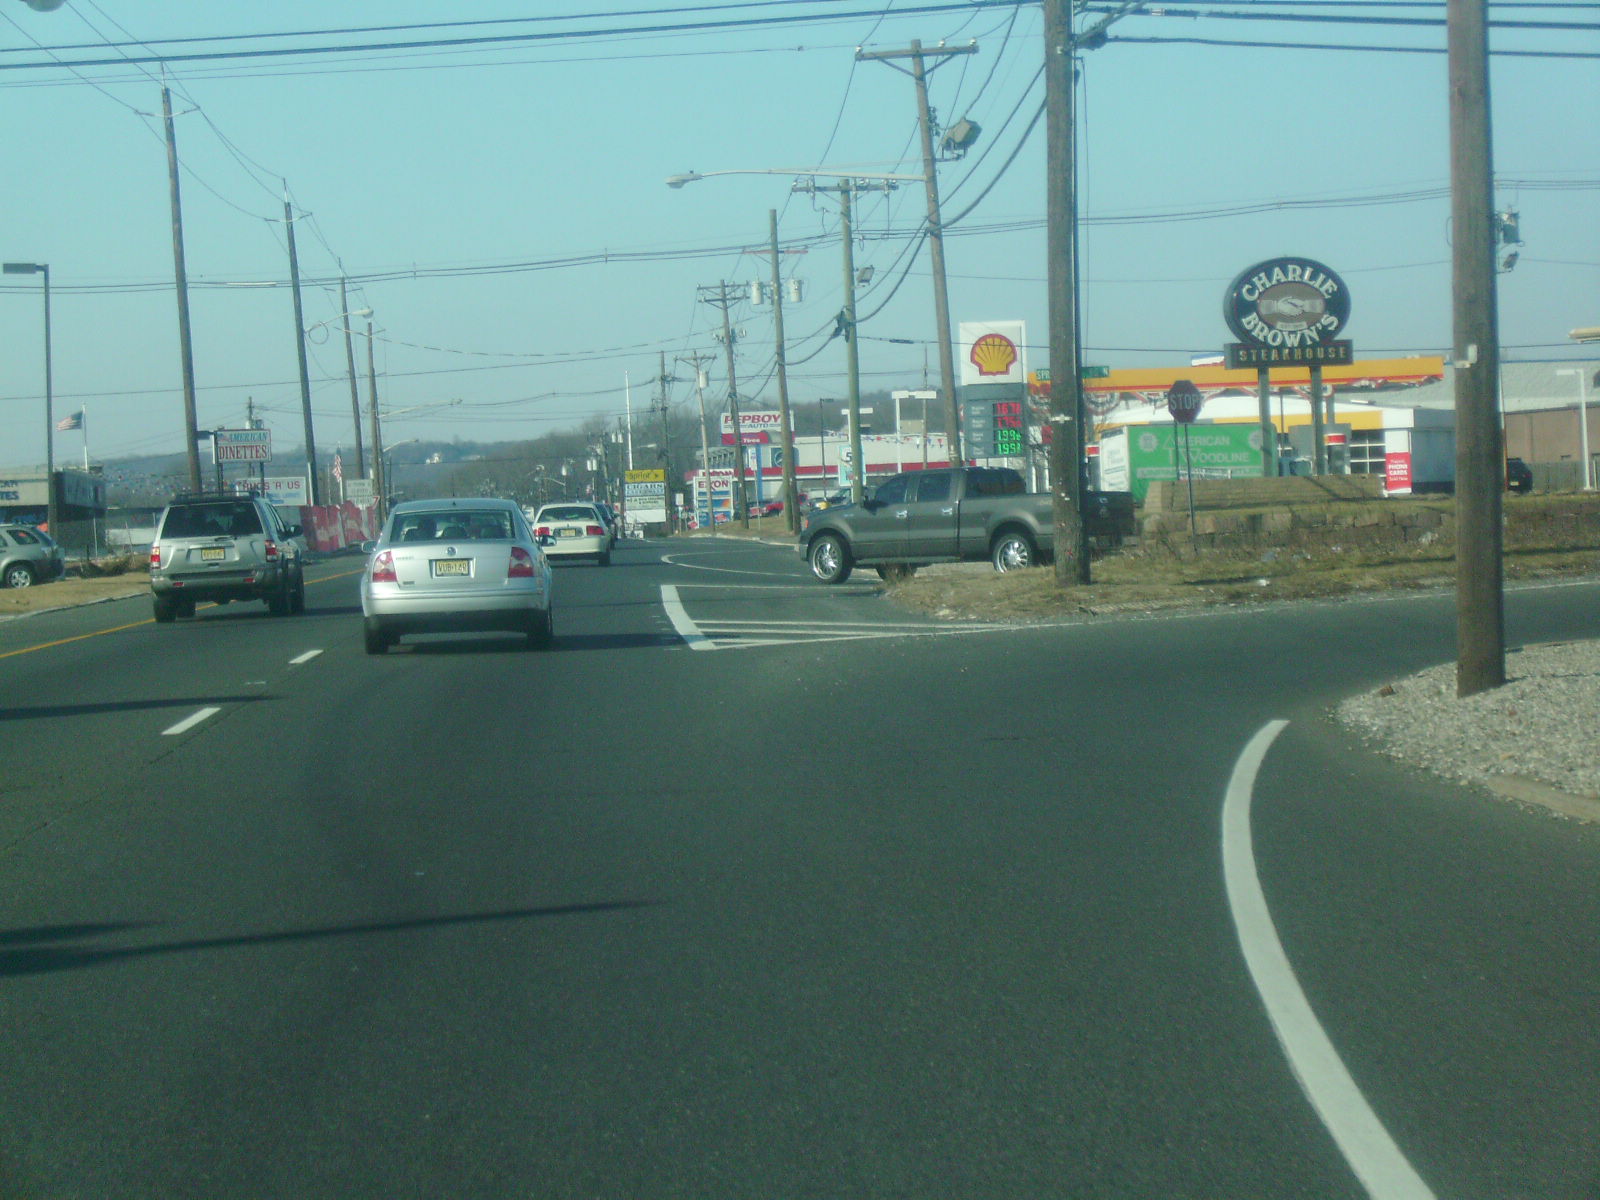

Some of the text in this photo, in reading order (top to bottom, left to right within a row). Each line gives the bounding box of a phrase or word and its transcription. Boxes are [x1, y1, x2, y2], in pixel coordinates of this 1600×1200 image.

[1242, 264, 1338, 301] CHARLIE
[1242, 312, 1338, 347] BROWN'S
[1239, 347, 1347, 361] STEAKHOUSE
[1170, 394, 1200, 410] STOP
[724, 414, 781, 424] PPBOY
[228, 431, 268, 442] AMERICAN
[1163, 434, 1230, 450] AMERICAN
[218, 445, 267, 460] DINETTES
[287, 481, 300, 489] US
[698, 480, 729, 491] EON
